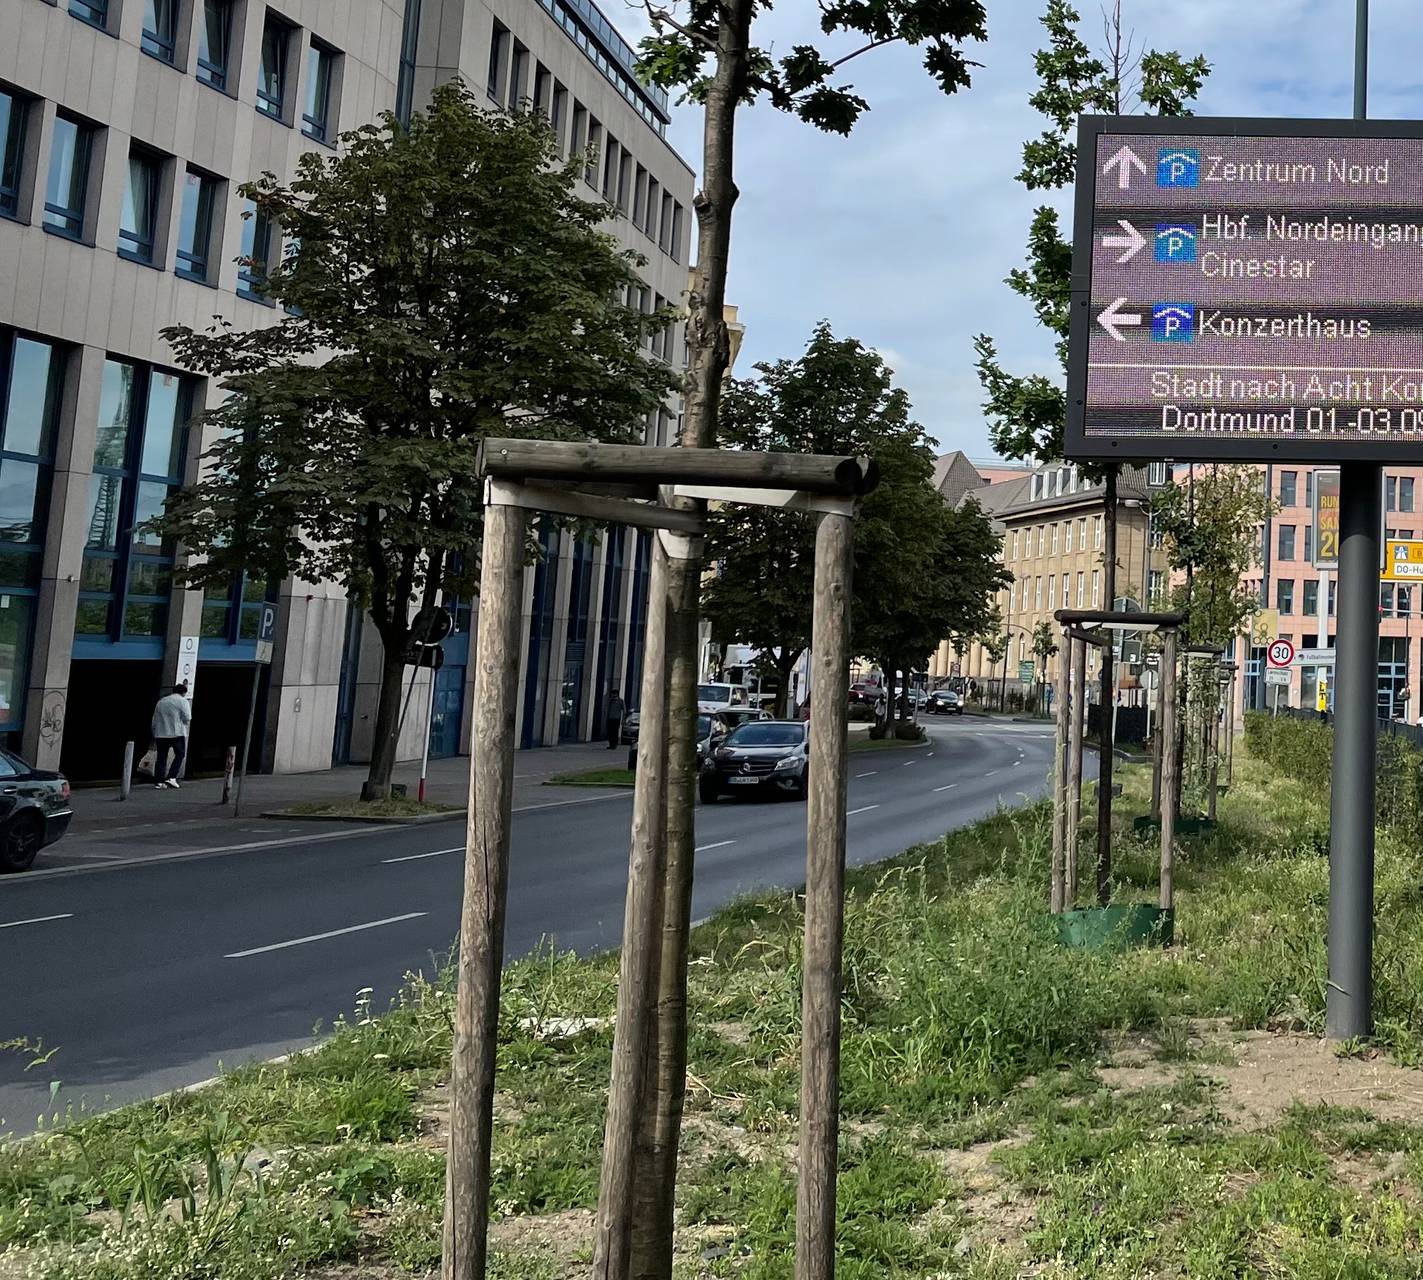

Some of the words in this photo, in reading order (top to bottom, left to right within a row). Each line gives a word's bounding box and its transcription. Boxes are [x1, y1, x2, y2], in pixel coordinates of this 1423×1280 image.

[1204, 155, 1315, 183] Zentrum
[1327, 158, 1390, 183] Nord
[1202, 214, 1252, 240] Hbf.
[1201, 251, 1316, 279] Cinestar
[1199, 310, 1371, 338] Konzerthaus
[1151, 371, 1222, 398] Stadt
[1231, 373, 1295, 399] nach
[1303, 375, 1371, 401] Acht
[1162, 405, 1294, 432] Dortmund
[262, 608, 274, 638] P
[1273, 646, 1289, 660] 30
